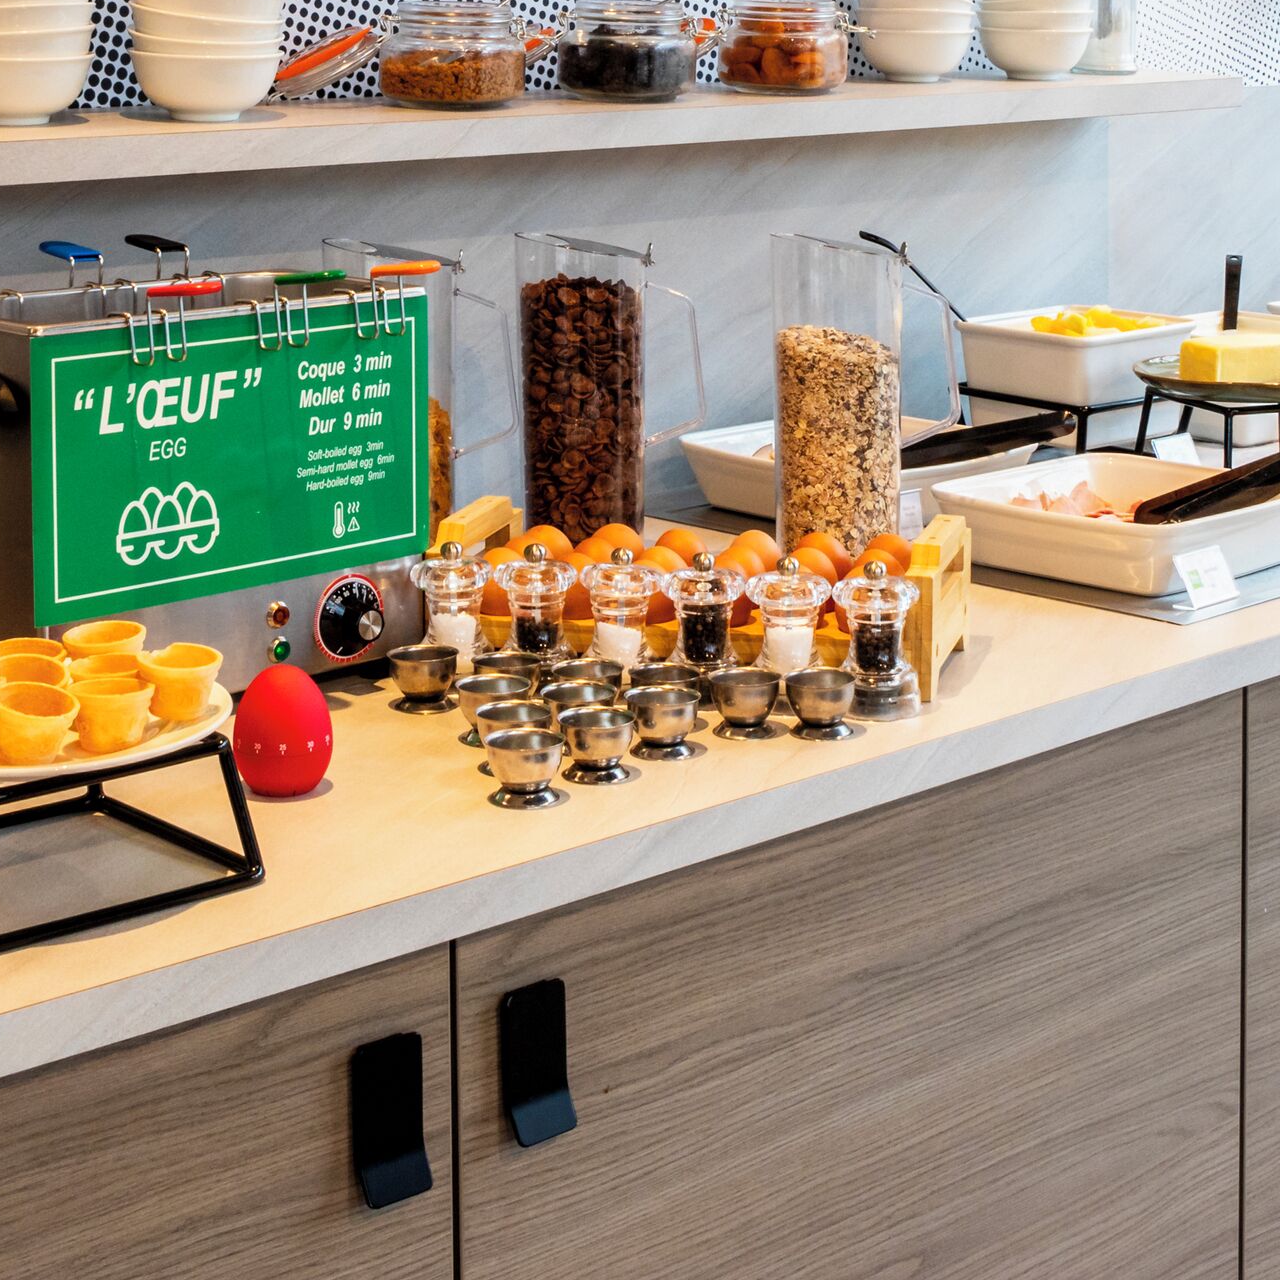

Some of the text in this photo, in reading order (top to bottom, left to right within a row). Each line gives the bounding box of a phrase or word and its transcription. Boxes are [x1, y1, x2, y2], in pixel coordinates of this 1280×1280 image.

[298, 351, 392, 382] Coque 3 min
[299, 379, 391, 409] Mollet 6 min
[308, 408, 383, 436] Dur 9 min
[149, 437, 187, 461] EGG
[308, 440, 384, 461] Soft-boiled egg 3min
[296, 453, 395, 478] Semi-hard mollet egg 6min
[306, 469, 386, 492] Hard-boiled egg 9min
[254, 742, 262, 750] 20
